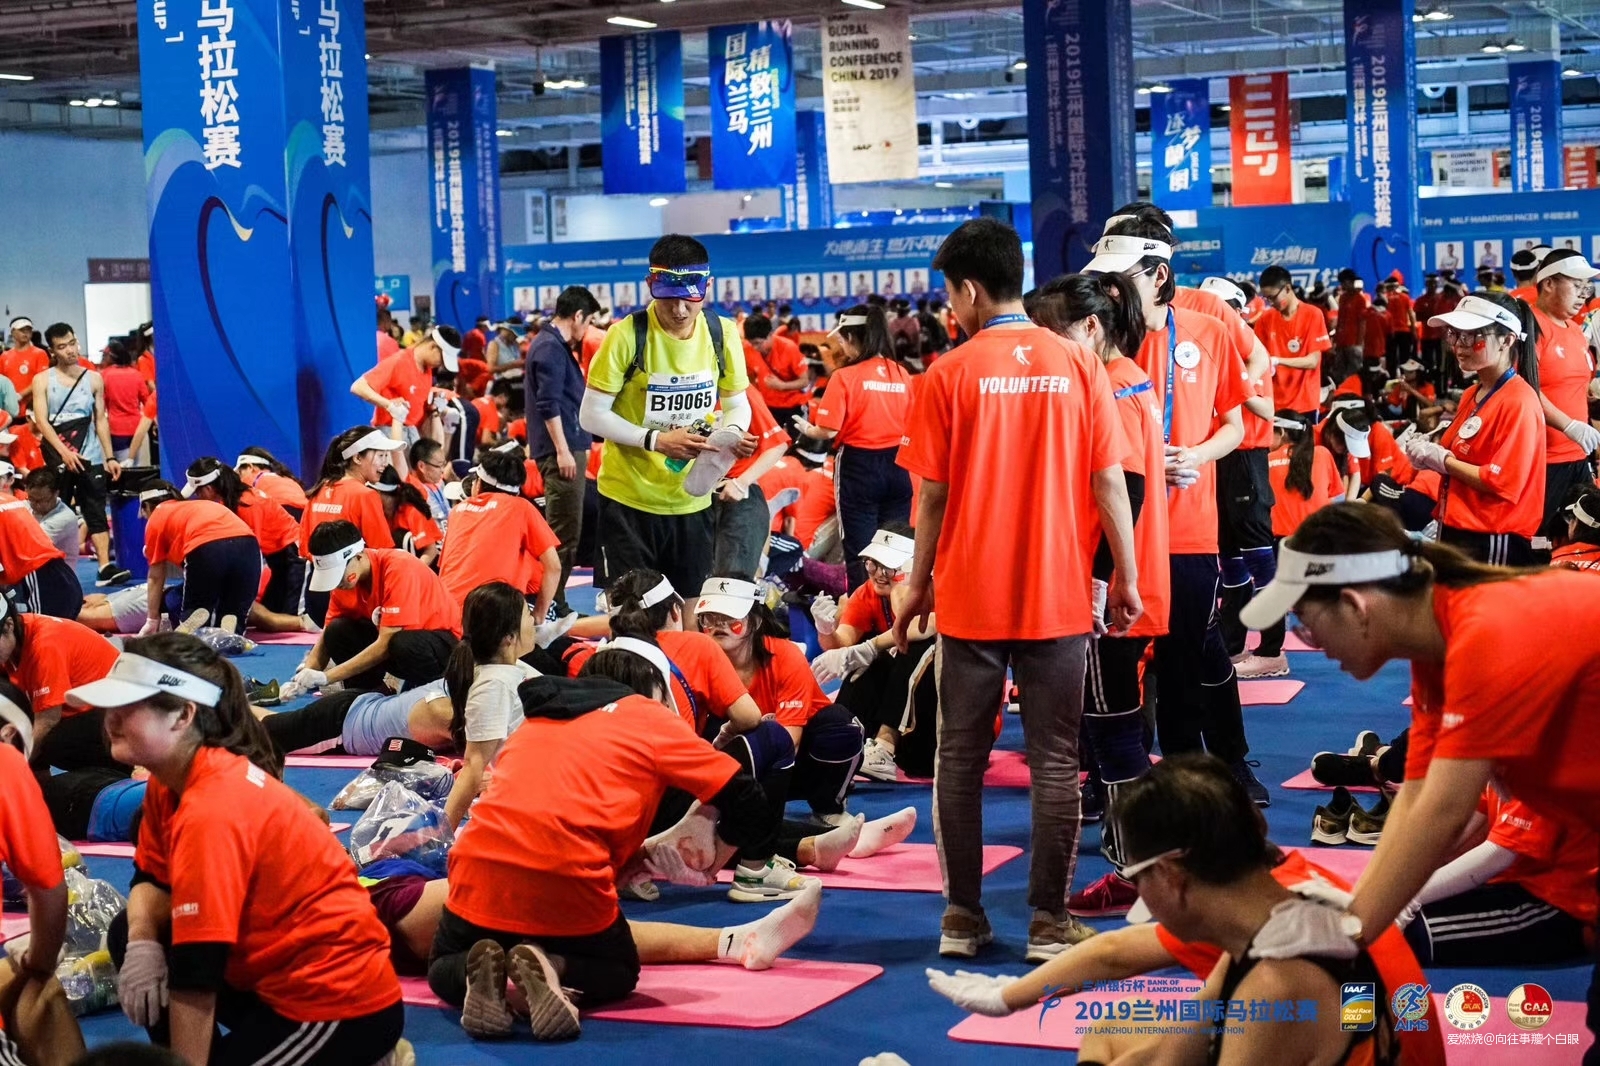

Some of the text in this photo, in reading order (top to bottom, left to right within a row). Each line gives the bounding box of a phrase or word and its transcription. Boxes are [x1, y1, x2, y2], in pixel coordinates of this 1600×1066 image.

[828, 24, 868, 37] GLOBAL
[829, 38, 879, 52] RUNNING
[829, 52, 903, 67] CONFERENCE
[831, 67, 899, 83] CHINA 2019
[196, 0, 242, 170] 马拉松赛
[317, 0, 347, 167] 马拉松赛
[862, 380, 906, 393] VOLUNTEER
[979, 376, 1070, 395] VOLUNTEER
[650, 391, 712, 411] B19065
